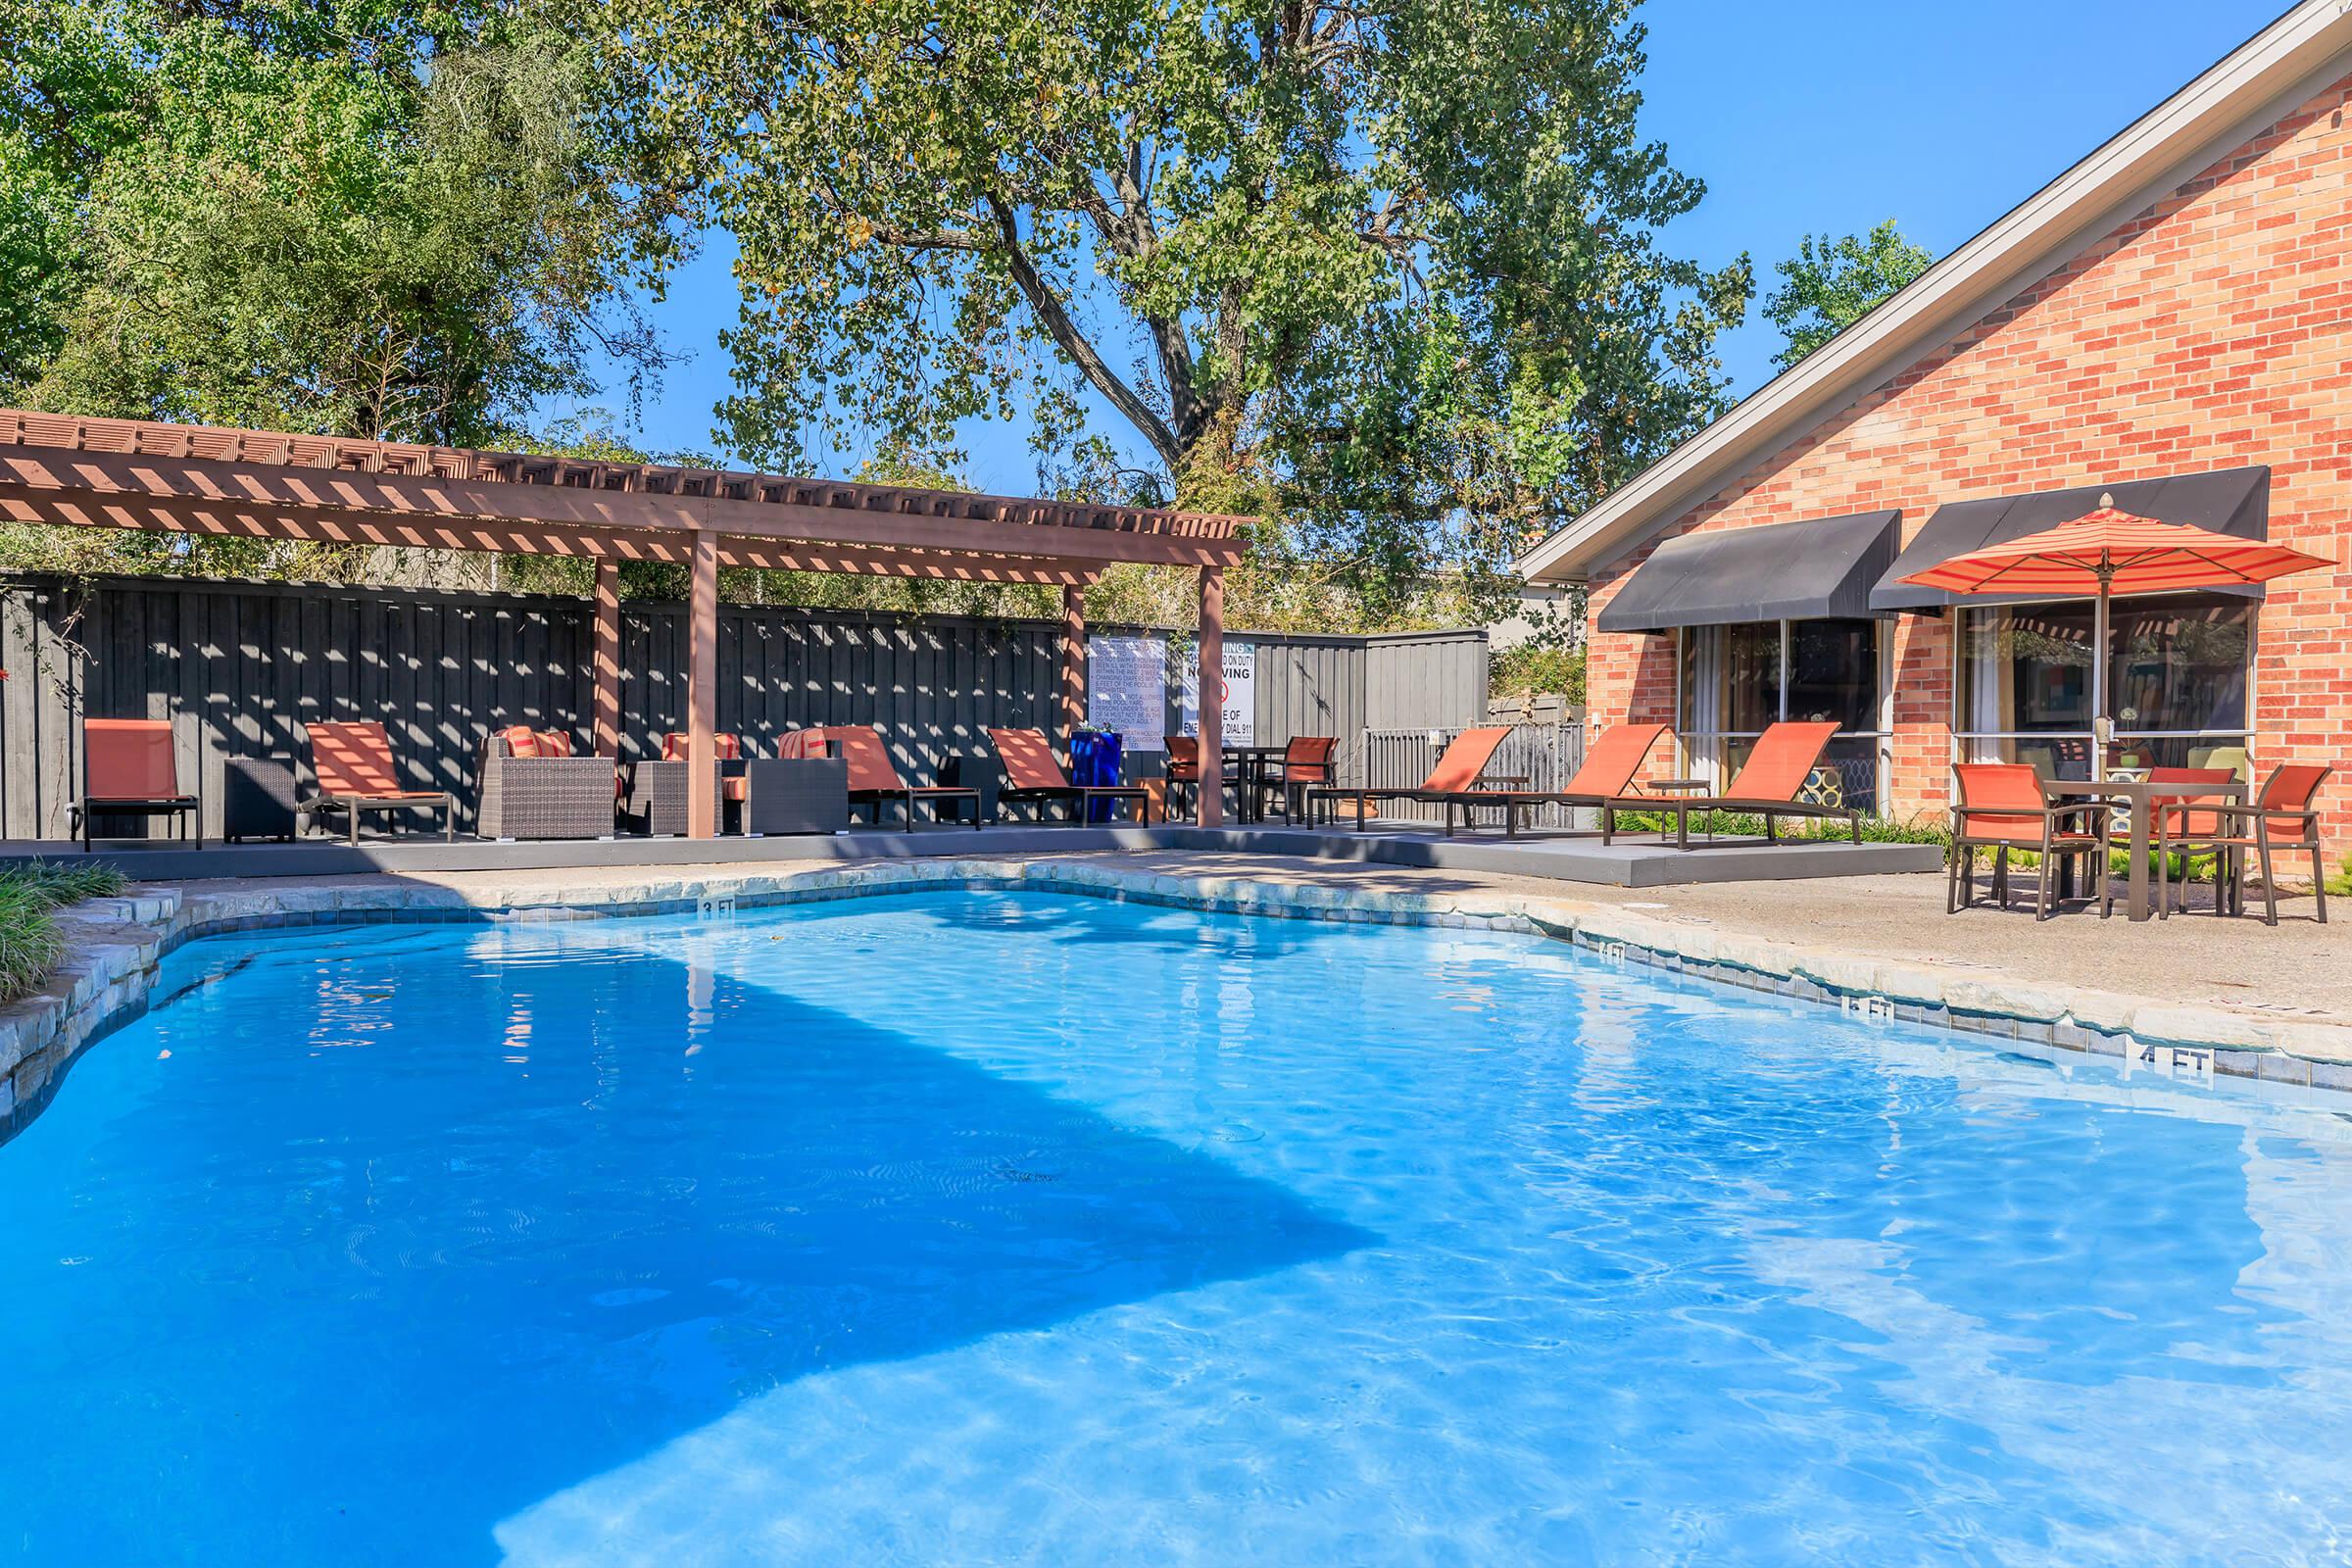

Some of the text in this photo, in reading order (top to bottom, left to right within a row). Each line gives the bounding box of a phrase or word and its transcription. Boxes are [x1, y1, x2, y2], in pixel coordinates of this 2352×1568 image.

[1228, 655, 1237, 665] ON
[1238, 656, 1253, 666] DUTY
[1230, 710, 1241, 720] OF
[1226, 724, 1241, 734] DIAL
[1242, 724, 1252, 734] 911
[704, 899, 734, 912] 3 FT
[1612, 945, 1624, 958] FT
[1869, 1000, 1891, 1017] FT
[2140, 1045, 2209, 1071] 4 FT
